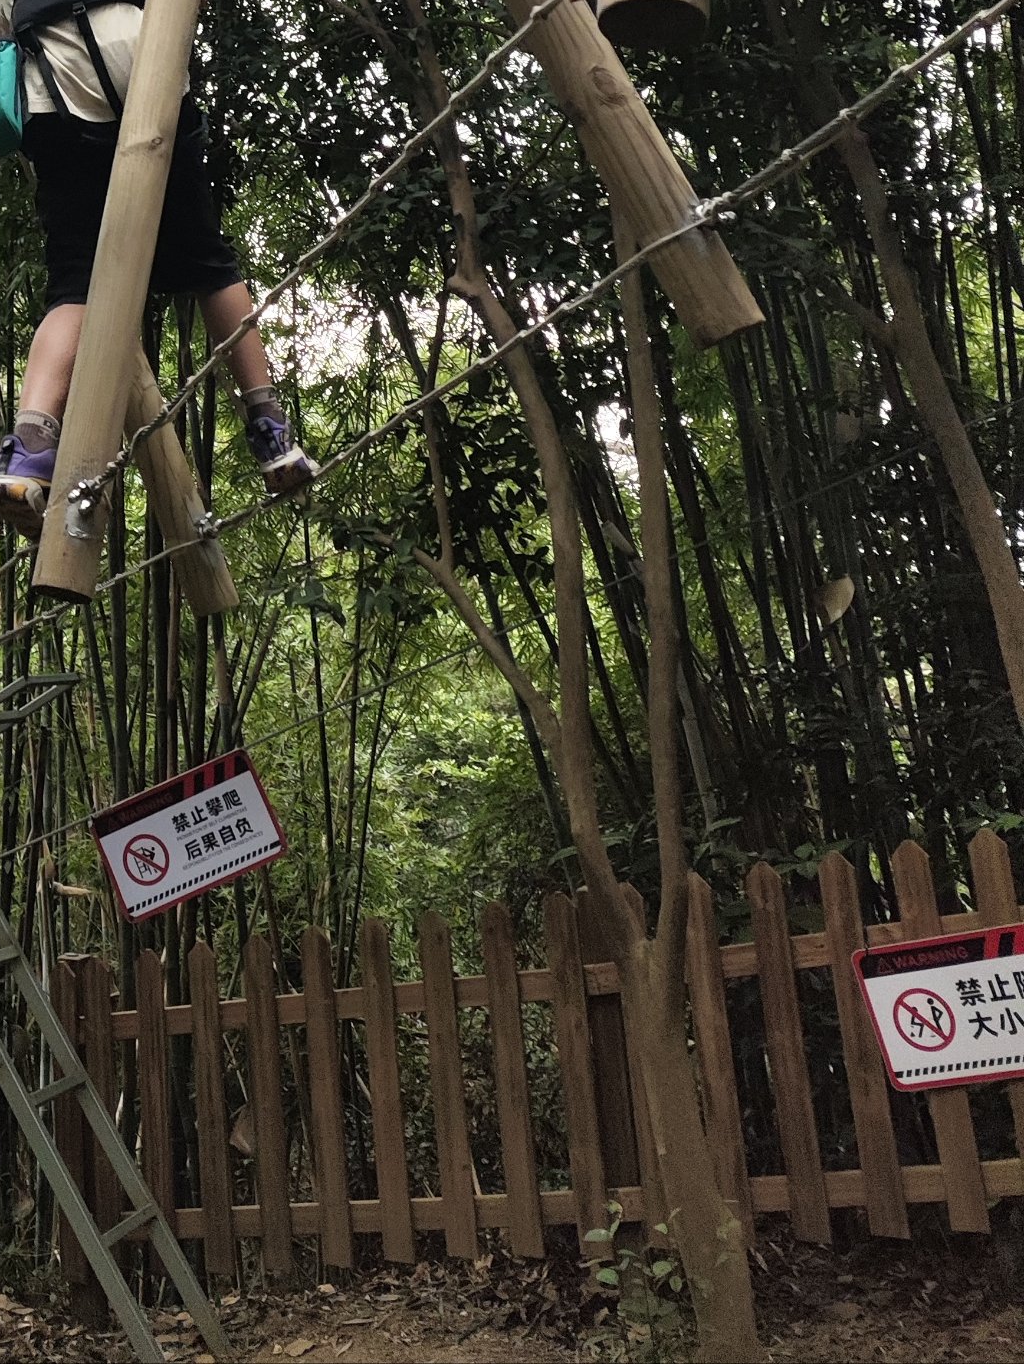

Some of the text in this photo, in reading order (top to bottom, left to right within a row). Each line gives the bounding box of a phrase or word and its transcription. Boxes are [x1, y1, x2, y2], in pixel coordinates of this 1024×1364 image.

[171, 789, 242, 833] 禁止攀爬
[184, 817, 253, 861] 后果自负
[893, 946, 968, 969] WARNING
[968, 1007, 1024, 1039] 大小
